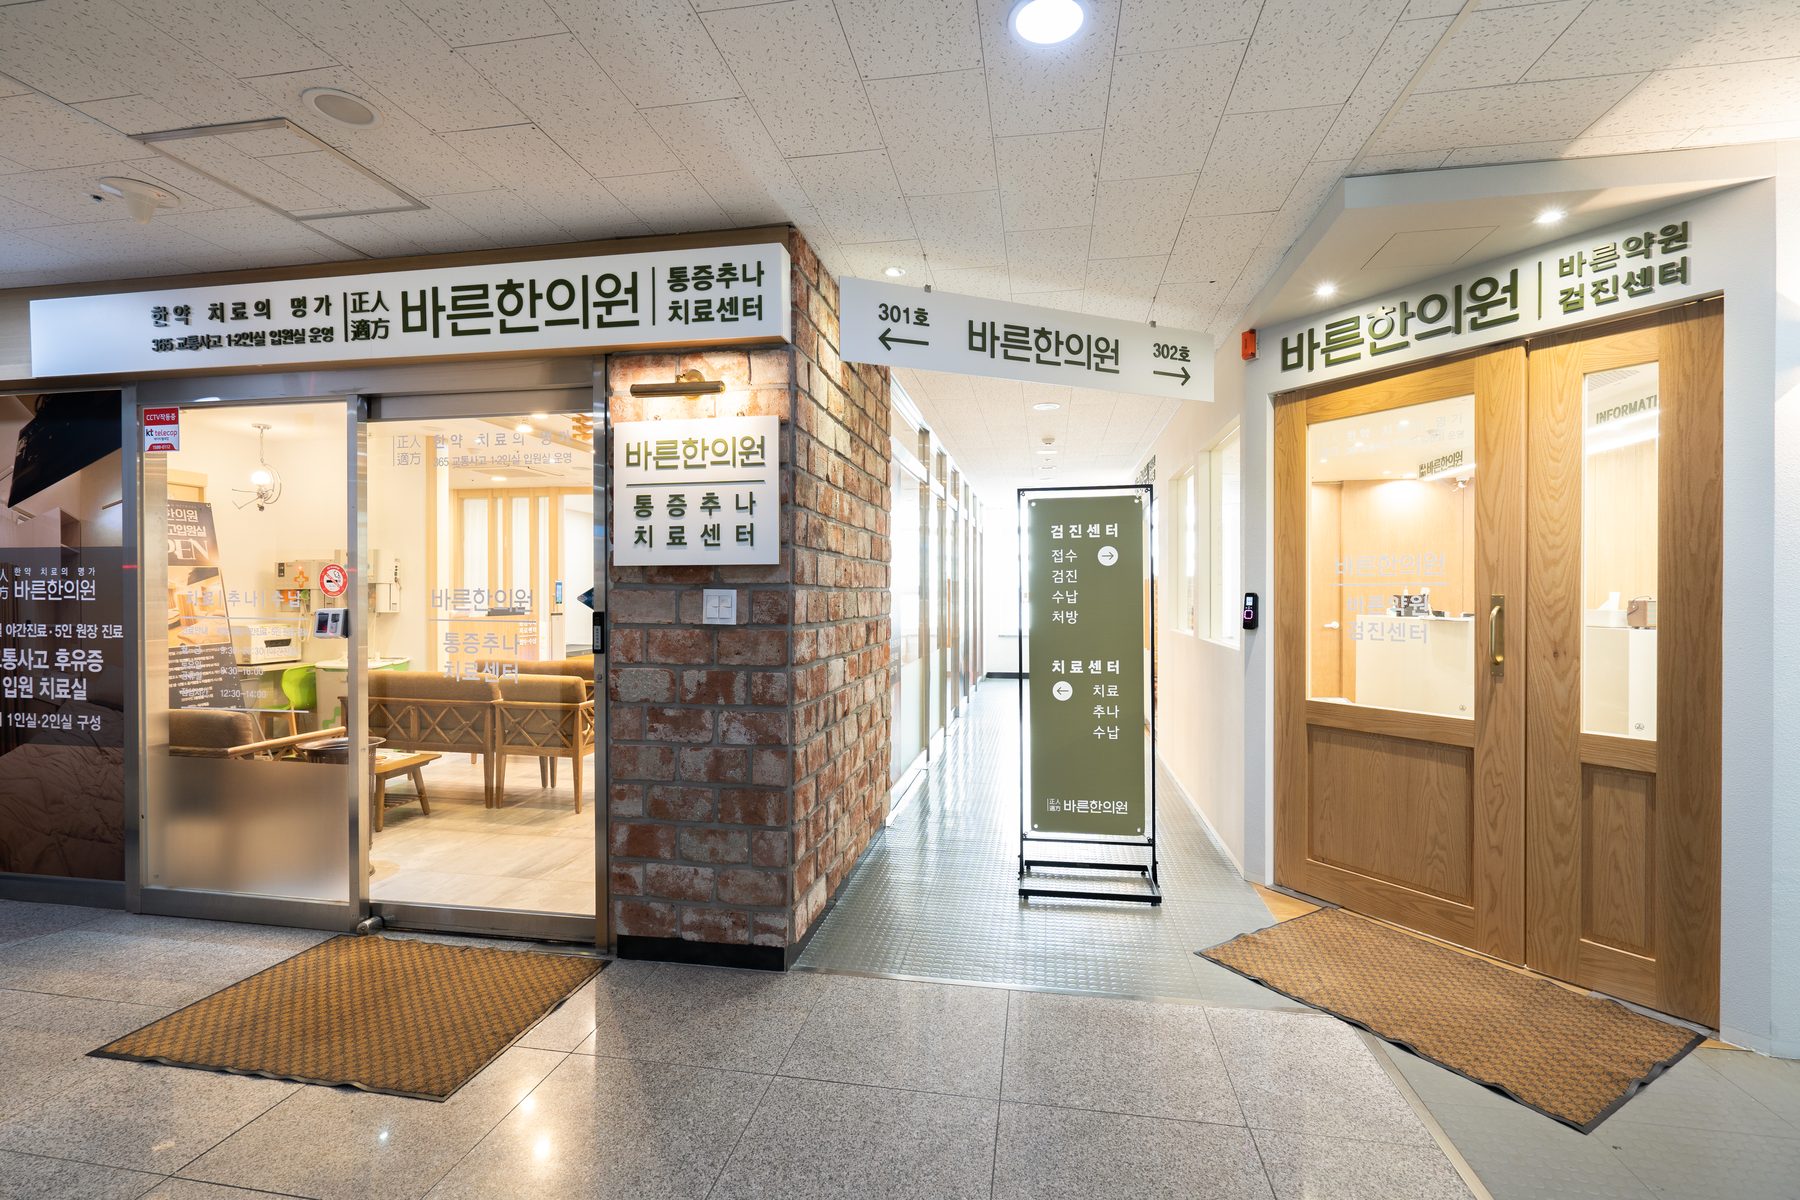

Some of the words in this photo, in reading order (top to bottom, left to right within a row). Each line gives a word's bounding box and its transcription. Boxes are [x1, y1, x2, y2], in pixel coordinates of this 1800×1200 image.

[1558, 220, 1691, 279] 바른약원
[666, 260, 766, 293] 통증추나
[1557, 255, 1690, 315] 검진센터
[150, 305, 192, 327] 한약
[207, 298, 272, 323] 치료의
[290, 294, 333, 317] 명가
[350, 290, 390, 313] 正人
[400, 271, 640, 339] 바른한의원
[667, 294, 765, 326] 치료센터
[877, 302, 930, 328] 301호
[1280, 267, 1520, 373] 바른한의원
[151, 338, 174, 353] 365
[175, 334, 223, 352] 교통사고
[269, 328, 306, 346] 입원실
[309, 326, 335, 343] 운영
[967, 318, 1120, 375] 바른한의원
[1152, 342, 1192, 364] 302호
[1596, 394, 1657, 424] INFORMATI
[145, 428, 154, 437] kt
[154, 429, 178, 438] telecop
[396, 434, 421, 449] 正人
[451, 453, 486, 468] 교통사고
[625, 435, 766, 471] 바른한의원
[633, 491, 757, 519] 통증추나
[633, 522, 755, 549] 치료센터
[1050, 523, 1119, 539] 검진센터
[1051, 549, 1078, 563] 접수
[14, 567, 32, 577] 한약
[40, 567, 69, 577] 치료의
[77, 567, 96, 577] 명가
[1051, 569, 1078, 584] 검진
[14, 579, 96, 601] 바른한의원
[228, 590, 258, 607] 추나
[431, 588, 533, 613] 바른한의원
[1051, 590, 1079, 604] 수납
[1052, 610, 1079, 624] 처방
[76, 623, 99, 639] 원장
[101, 624, 124, 639] 진료
[1347, 621, 1428, 644] 검진센터
[442, 632, 520, 655] 통증추나
[0, 648, 49, 671] 통사고
[54, 648, 104, 672] 후유증
[1051, 660, 1120, 674] 치료센터
[443, 661, 520, 684] 치료센터
[2, 675, 34, 698] 입원
[39, 676, 87, 701] 치료실
[1092, 684, 1119, 698] 치료
[76, 715, 102, 731] 구성
[1092, 704, 1120, 719] 추나
[1092, 725, 1120, 740] 수납
[1063, 799, 1128, 815] 바른한의원
